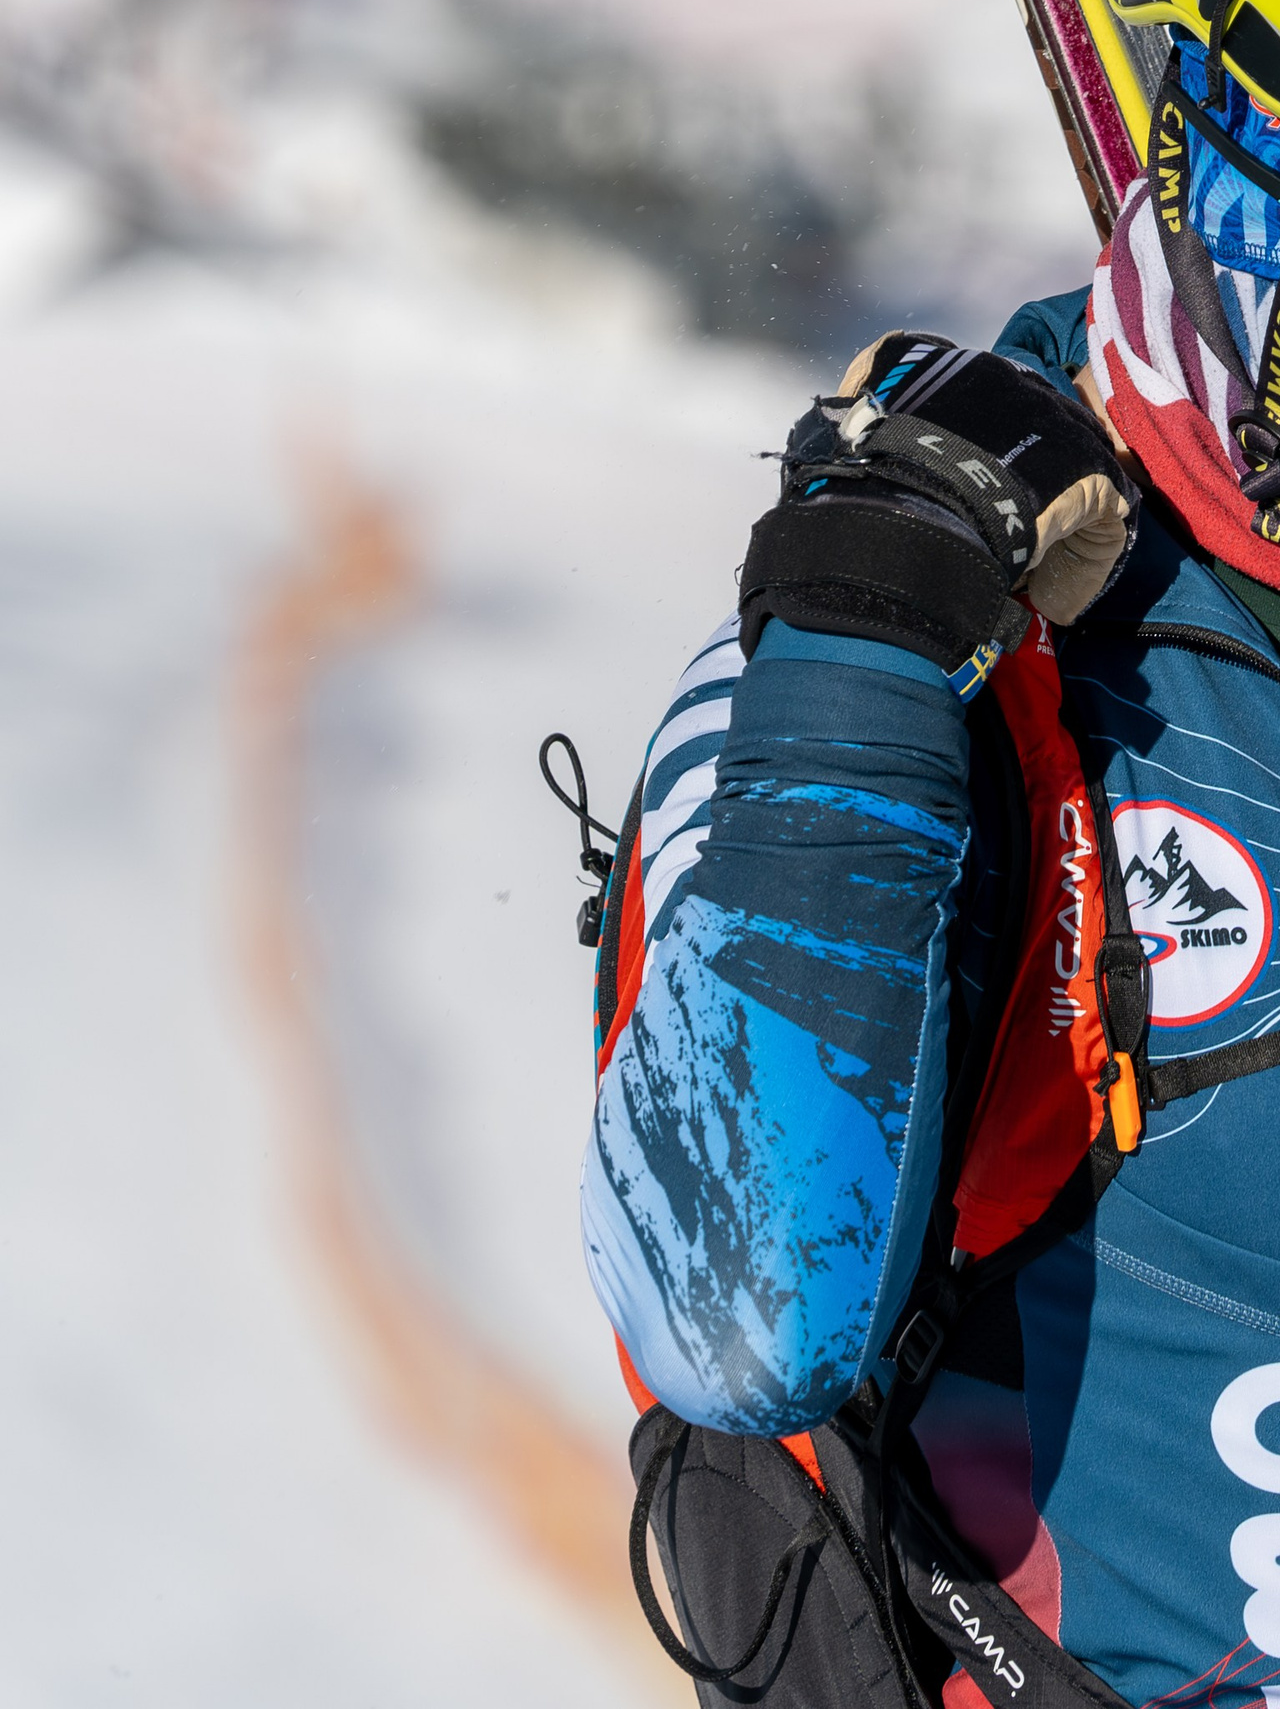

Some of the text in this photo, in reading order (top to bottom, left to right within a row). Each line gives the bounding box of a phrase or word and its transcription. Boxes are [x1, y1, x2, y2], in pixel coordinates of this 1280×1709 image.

[1159, 101, 1184, 233] CAMP
[995, 445, 1026, 468] hermo
[1180, 926, 1248, 949] SKIMO
